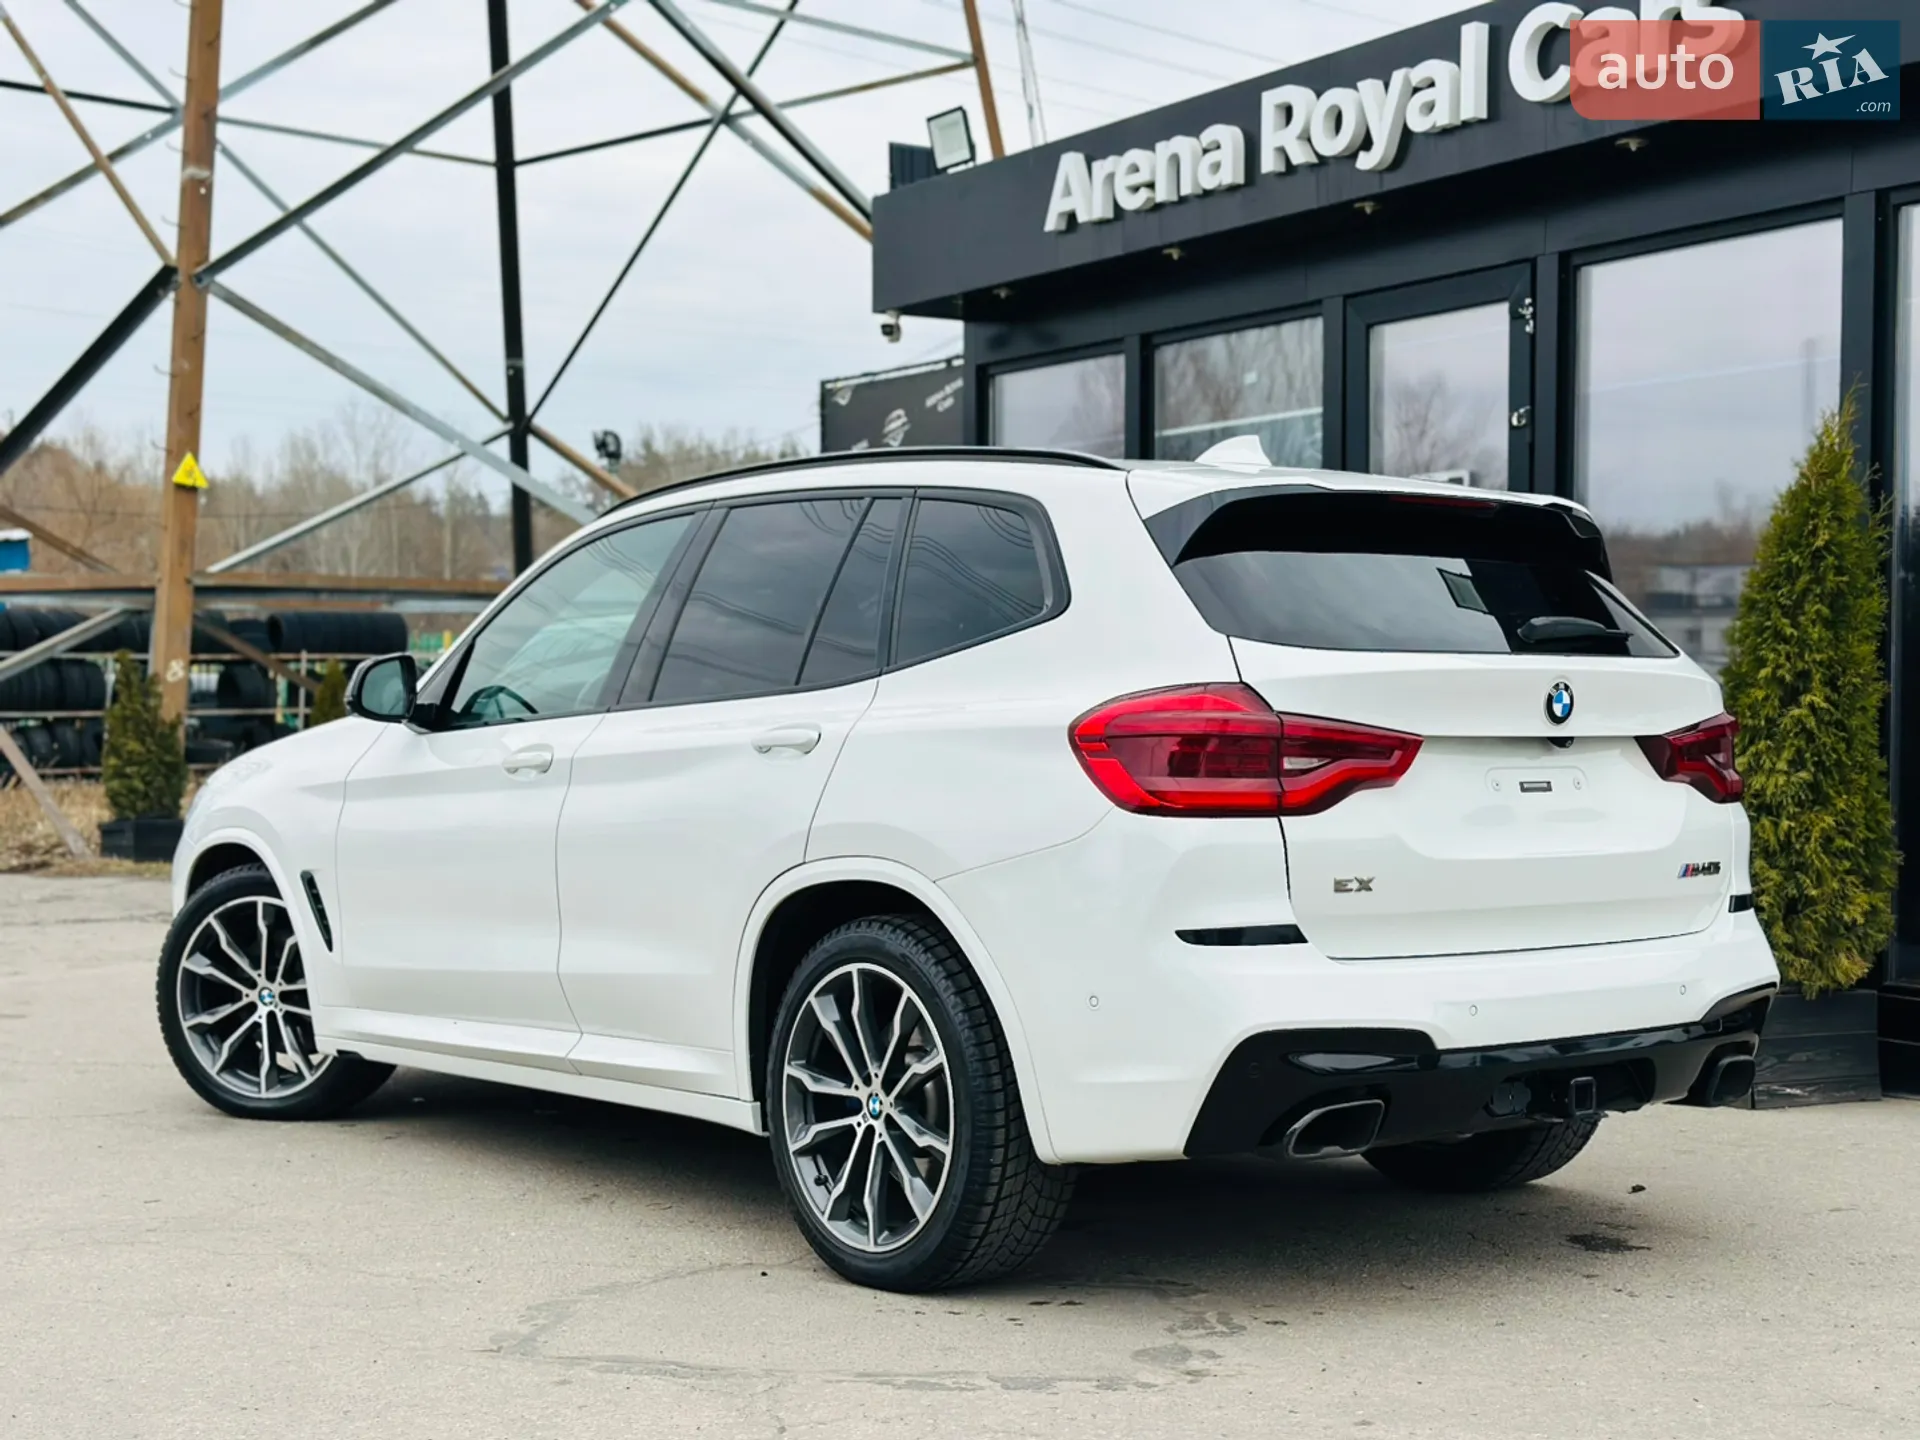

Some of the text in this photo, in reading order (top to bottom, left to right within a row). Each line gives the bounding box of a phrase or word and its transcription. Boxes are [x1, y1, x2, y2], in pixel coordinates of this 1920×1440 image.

[1043, 124, 1246, 233] Arena
[1261, 21, 1490, 172] Royal
[1333, 876, 1376, 893] EX
